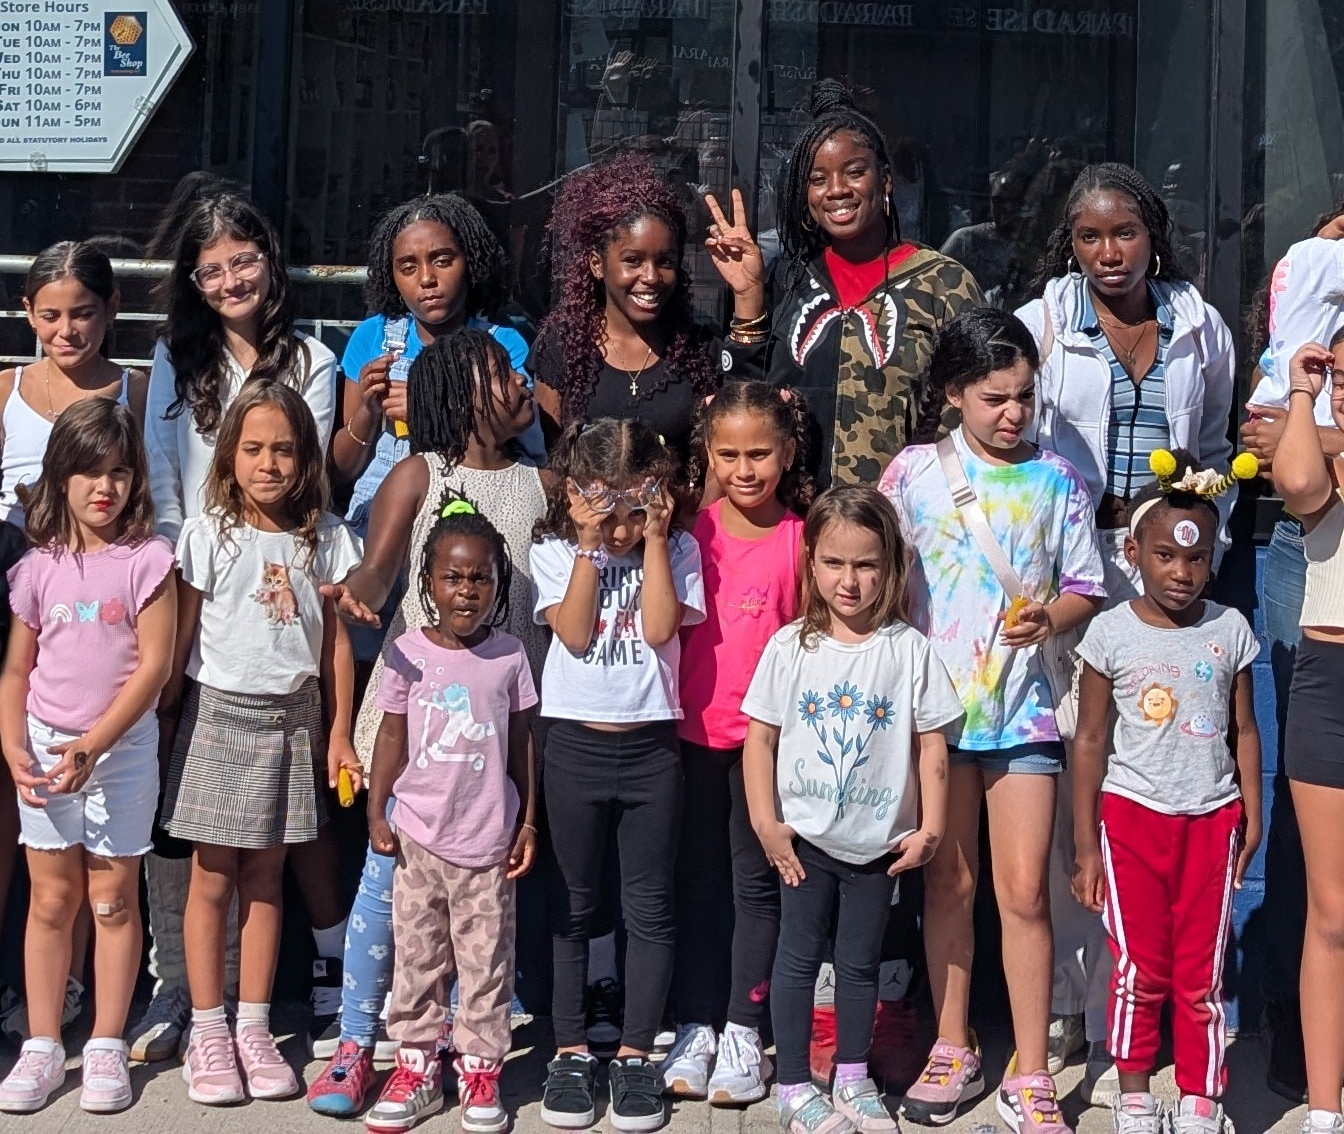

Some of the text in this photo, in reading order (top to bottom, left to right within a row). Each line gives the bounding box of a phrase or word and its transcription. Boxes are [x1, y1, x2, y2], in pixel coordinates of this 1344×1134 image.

[1, 1, 89, 12] Store Hours
[25, 20, 60, 31] 10AM
[74, 20, 100, 31] 7PM
[26, 36, 60, 47] 10AM
[75, 36, 101, 47] 7PM
[26, 52, 61, 63] 10AM
[75, 51, 101, 63] 7PM
[114, 50, 131, 59] Bee
[120, 58, 143, 69] Shop
[26, 68, 61, 79] 10AM
[75, 67, 101, 79] 7PM
[26, 83, 61, 95] 10AM
[75, 83, 101, 95] 7PM
[25, 99, 60, 111] 10AM
[75, 99, 101, 110] 6PM
[25, 115, 60, 127] 11AM
[75, 115, 100, 126] 5PM
[598, 566, 643, 588] RING
[599, 586, 642, 611] OUR
[583, 639, 643, 667] GAME
